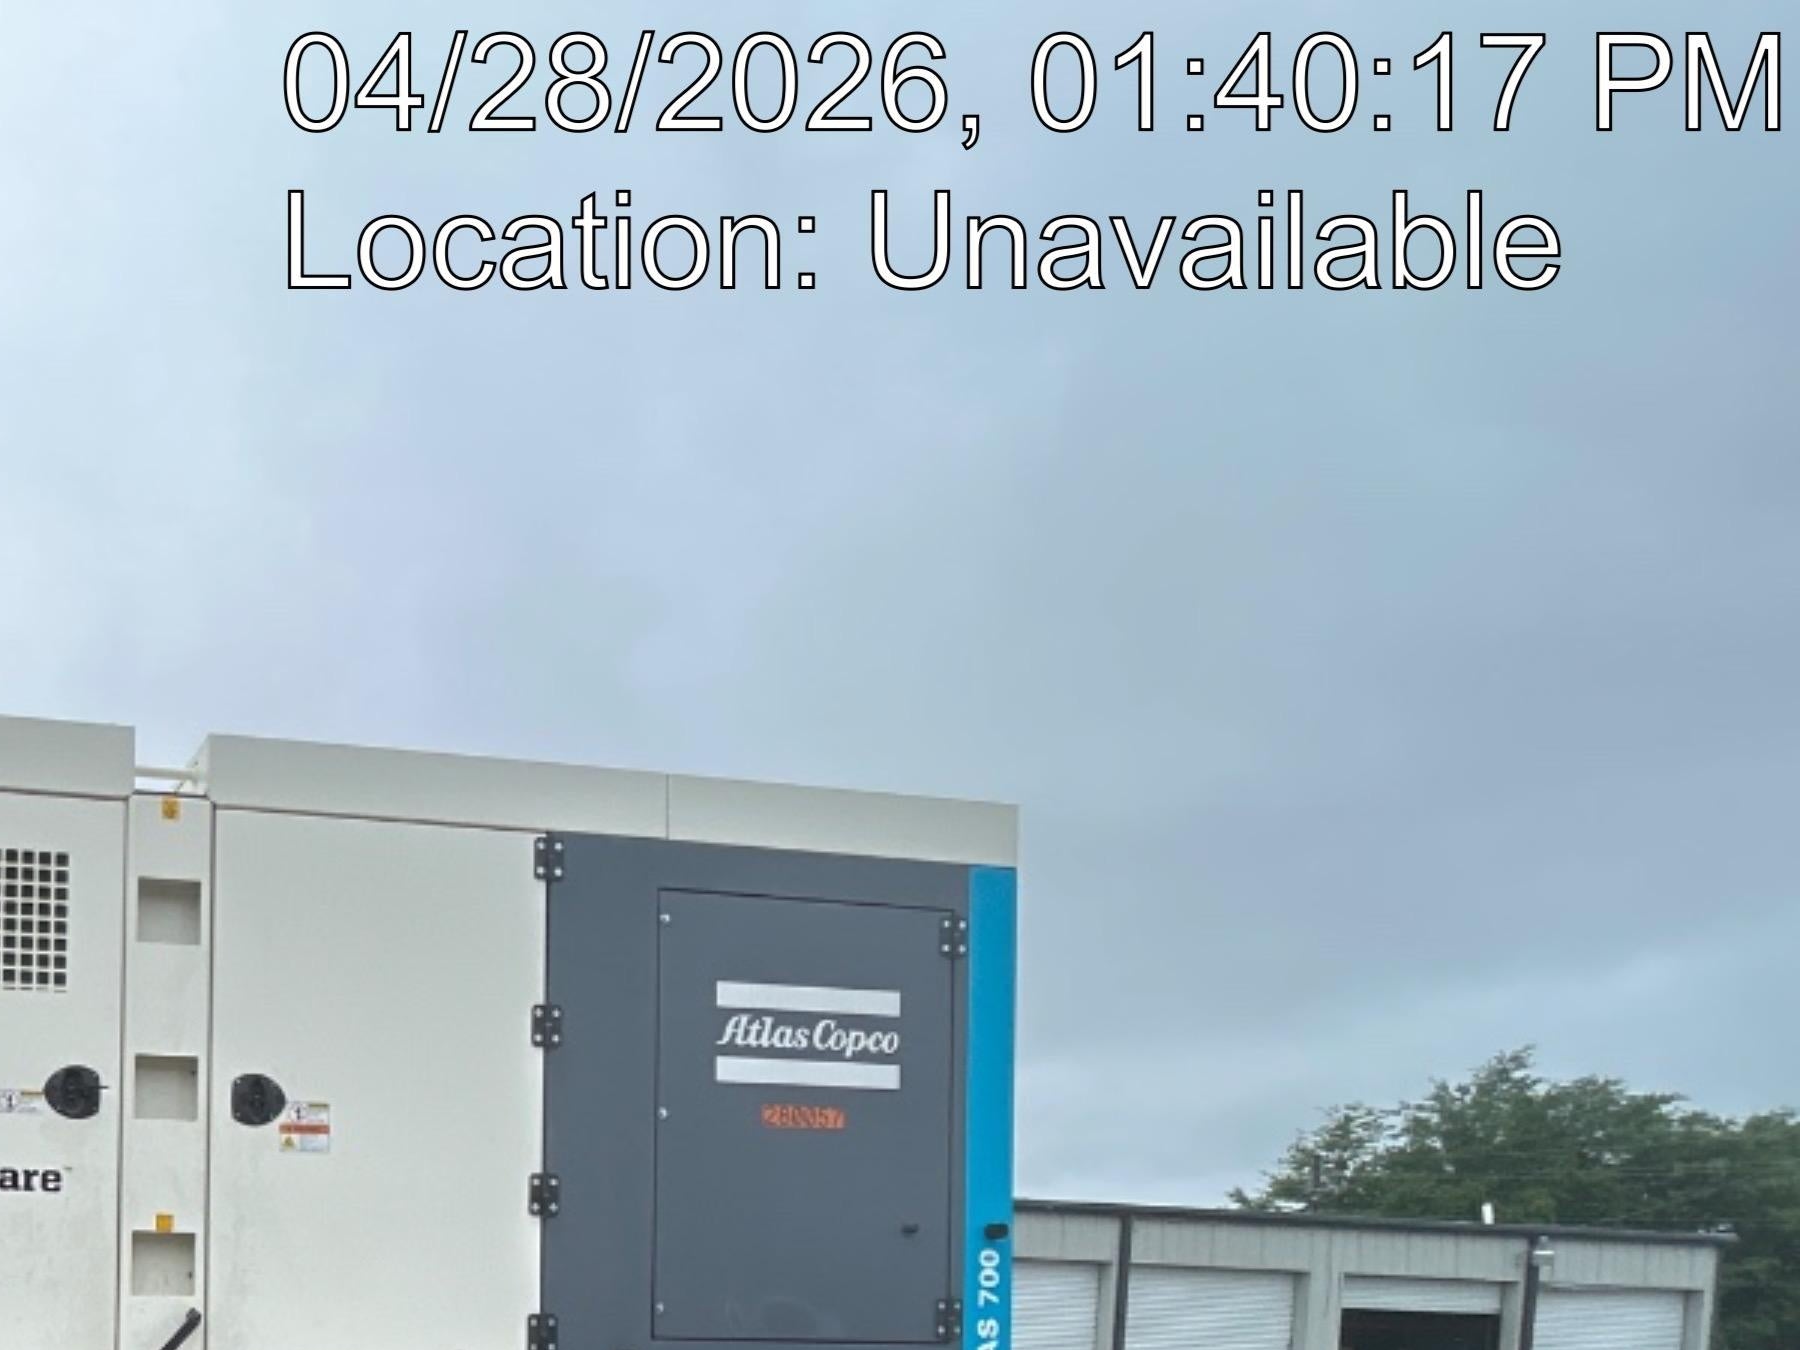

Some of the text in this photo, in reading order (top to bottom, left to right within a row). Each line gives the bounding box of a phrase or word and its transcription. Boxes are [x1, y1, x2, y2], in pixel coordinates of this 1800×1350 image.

[717, 1013, 900, 1059] Atlas Copco
[977, 1249, 1001, 1309] 700
